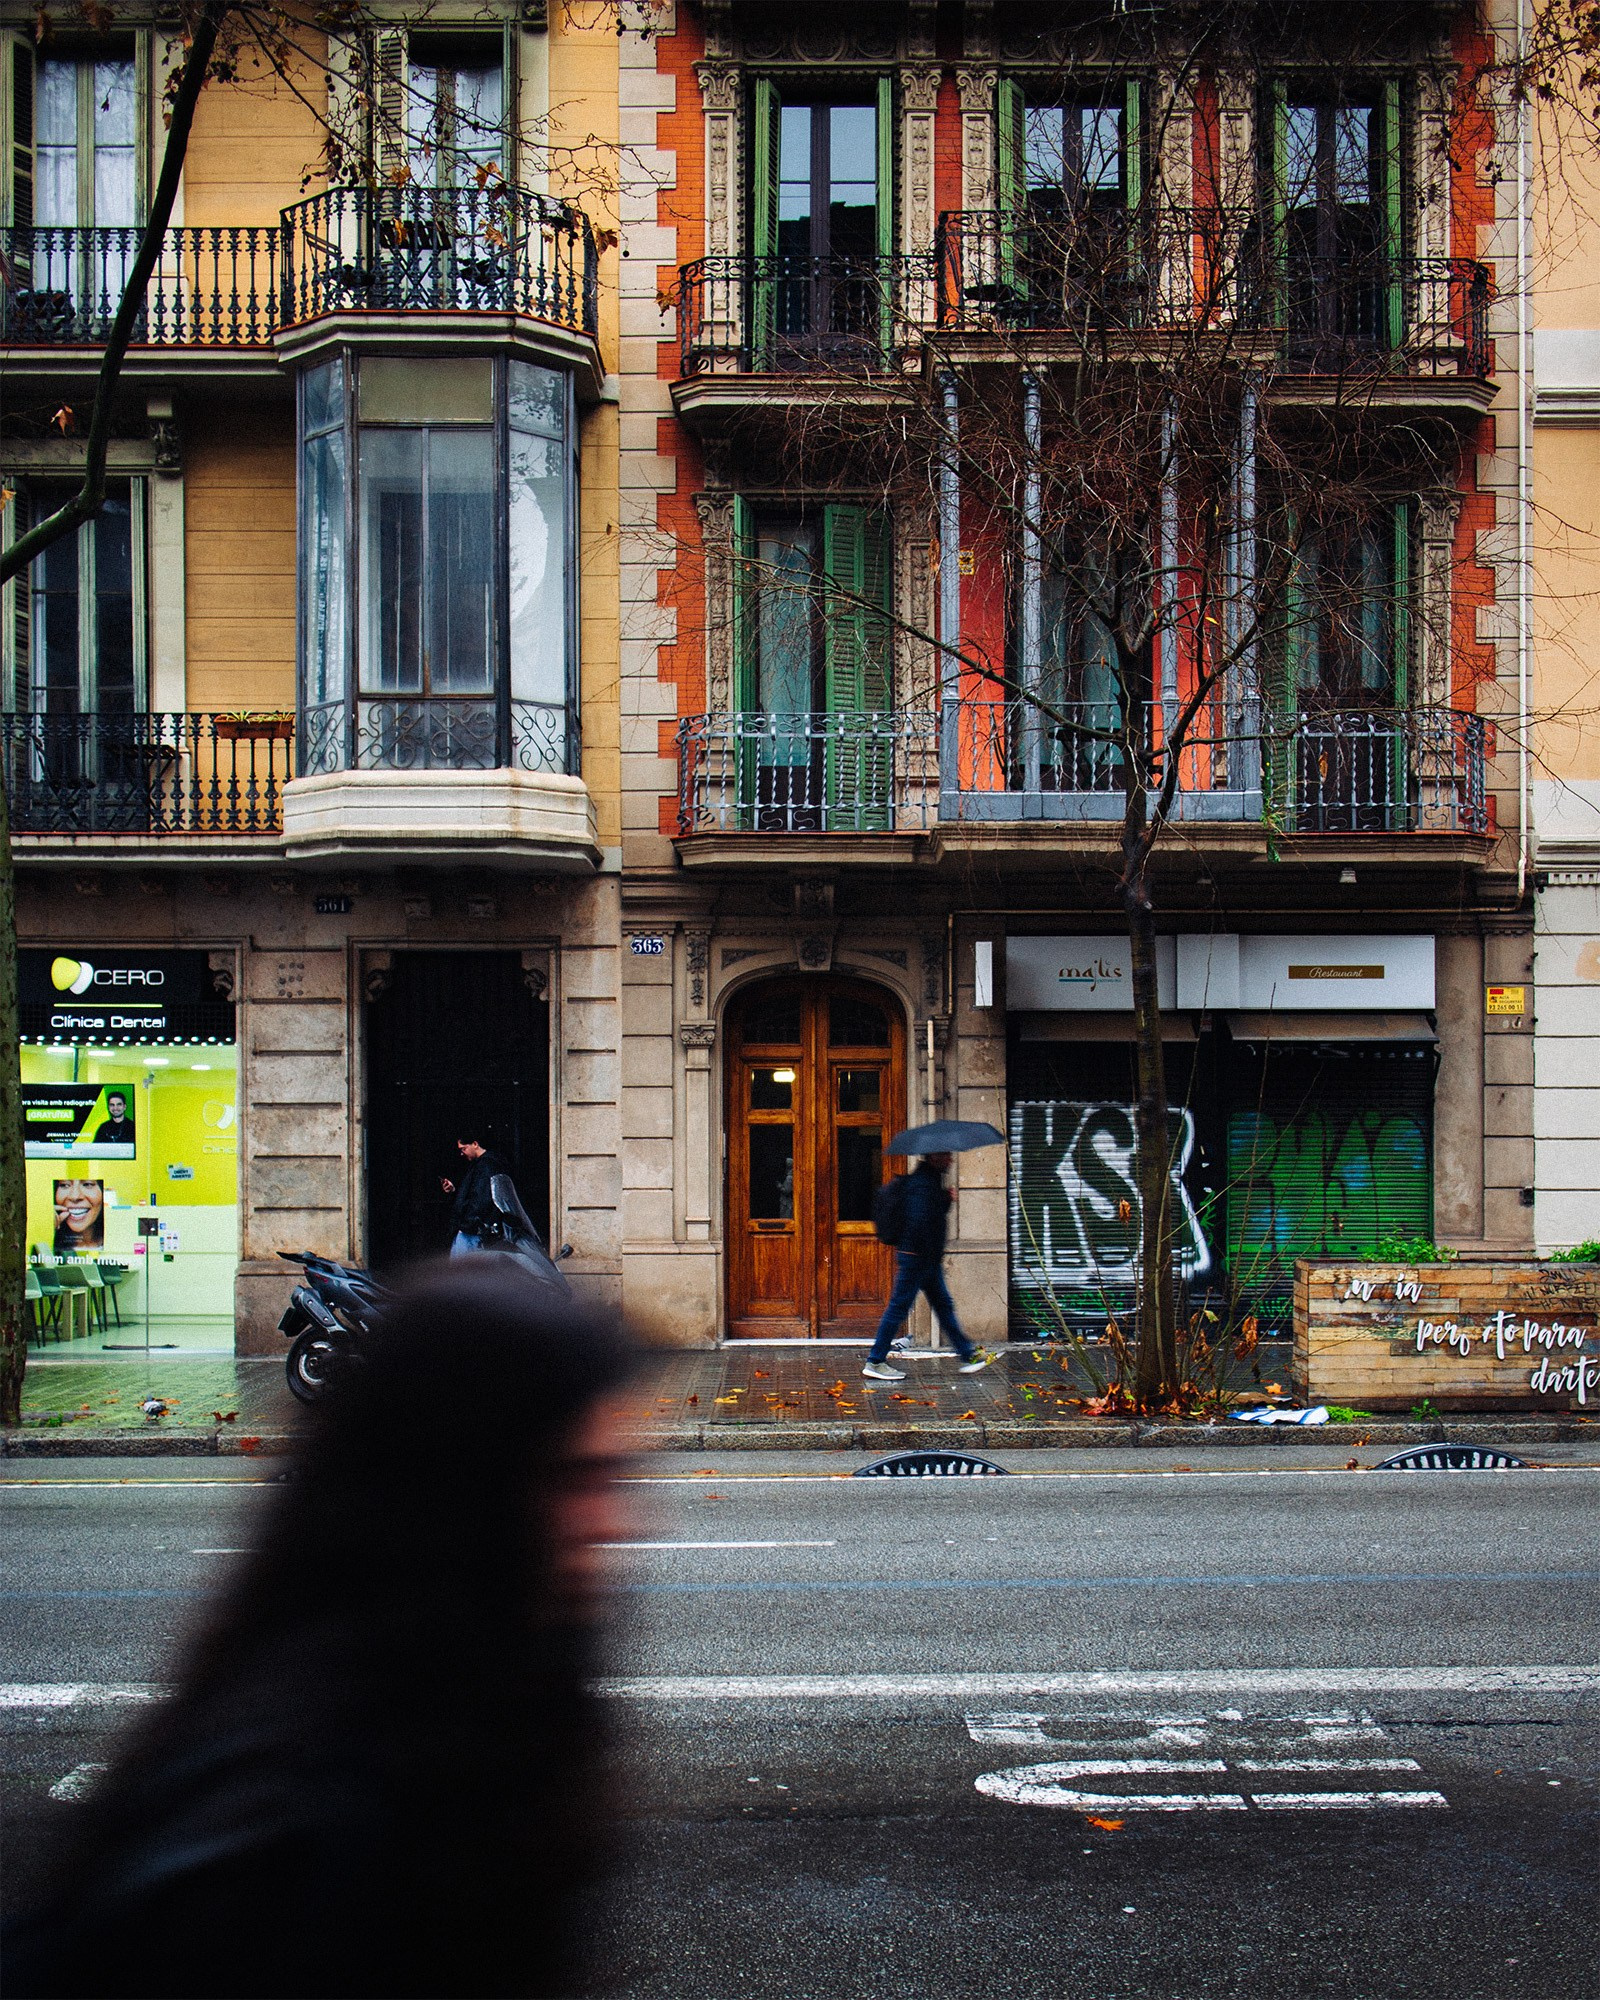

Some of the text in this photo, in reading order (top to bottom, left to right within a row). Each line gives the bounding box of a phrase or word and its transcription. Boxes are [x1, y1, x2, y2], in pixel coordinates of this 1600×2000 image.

[633, 938, 662, 954] 363
[93, 969, 165, 986] CERO
[1058, 957, 1122, 992] majlis
[1308, 966, 1363, 978] Restaurant
[50, 1014, 166, 1028] Clínica Dental
[66, 1253, 94, 1266] amb
[1523, 1319, 1588, 1353] para
[1530, 1355, 1600, 1406] darte
